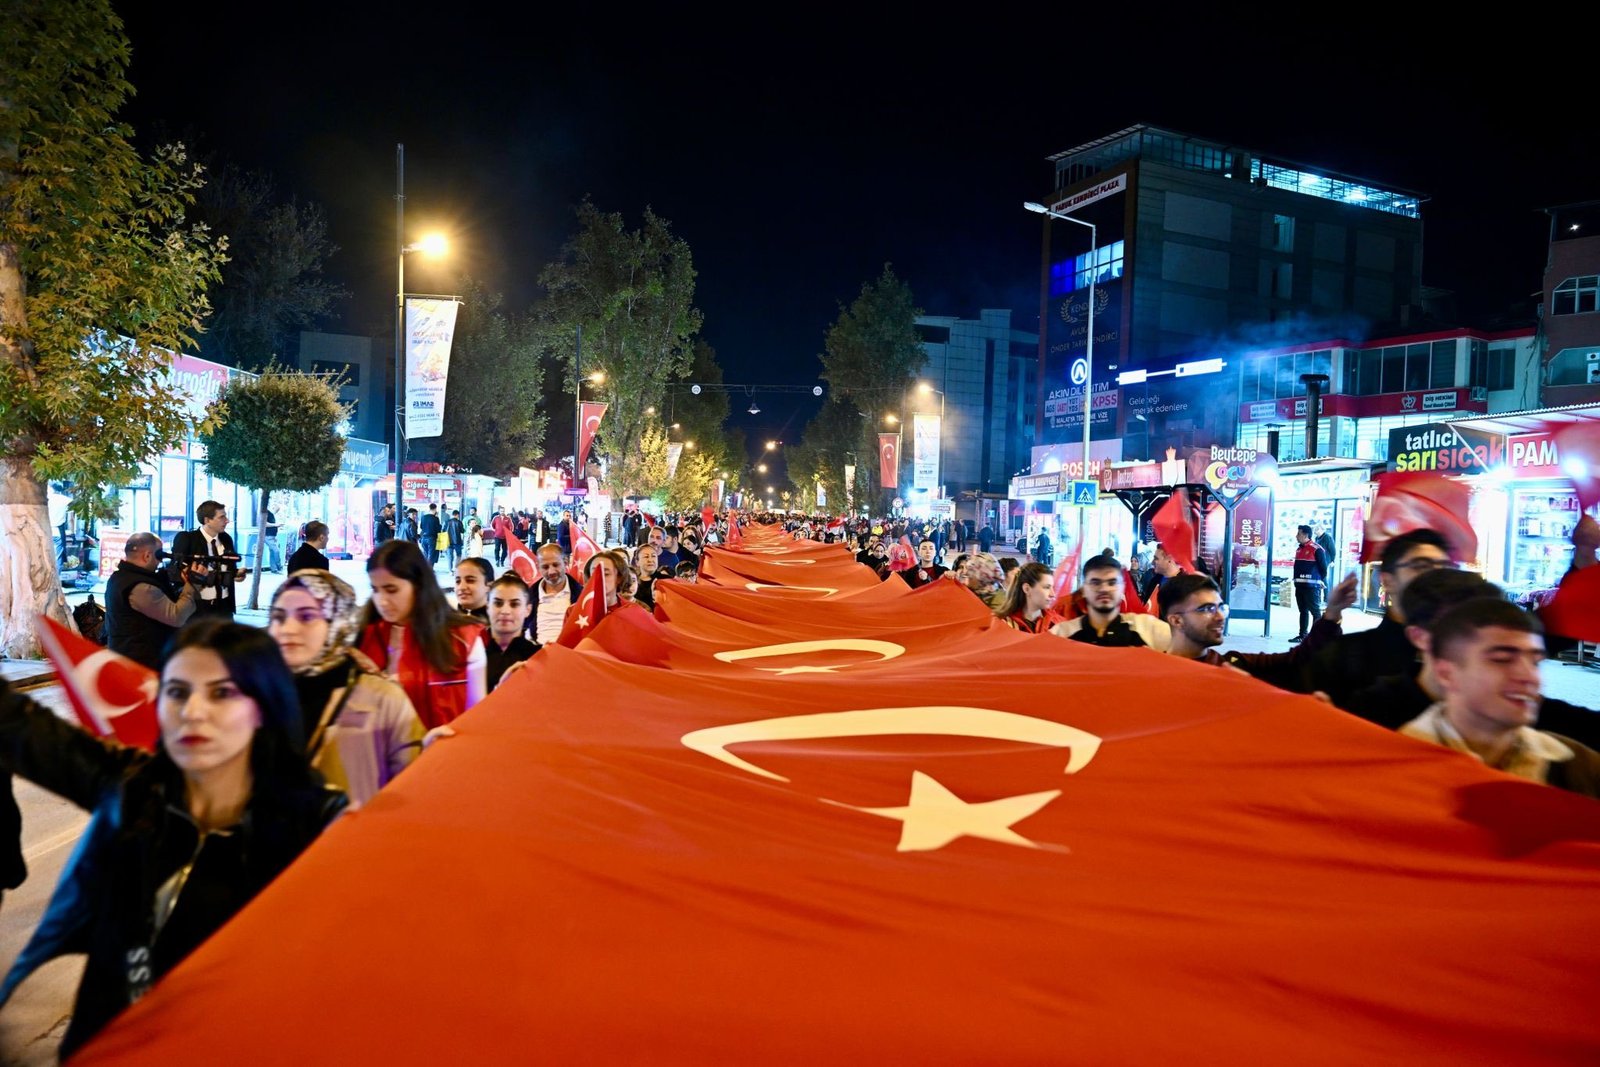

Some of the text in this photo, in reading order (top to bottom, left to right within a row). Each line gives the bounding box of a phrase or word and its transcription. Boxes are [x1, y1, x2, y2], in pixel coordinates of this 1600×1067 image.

[1092, 394, 1117, 408] KPSS
[1155, 402, 1188, 413] edenlere
[1406, 430, 1457, 450] tatlıcı
[1210, 446, 1256, 464] Beytepe
[406, 481, 428, 490] Ciğerc
